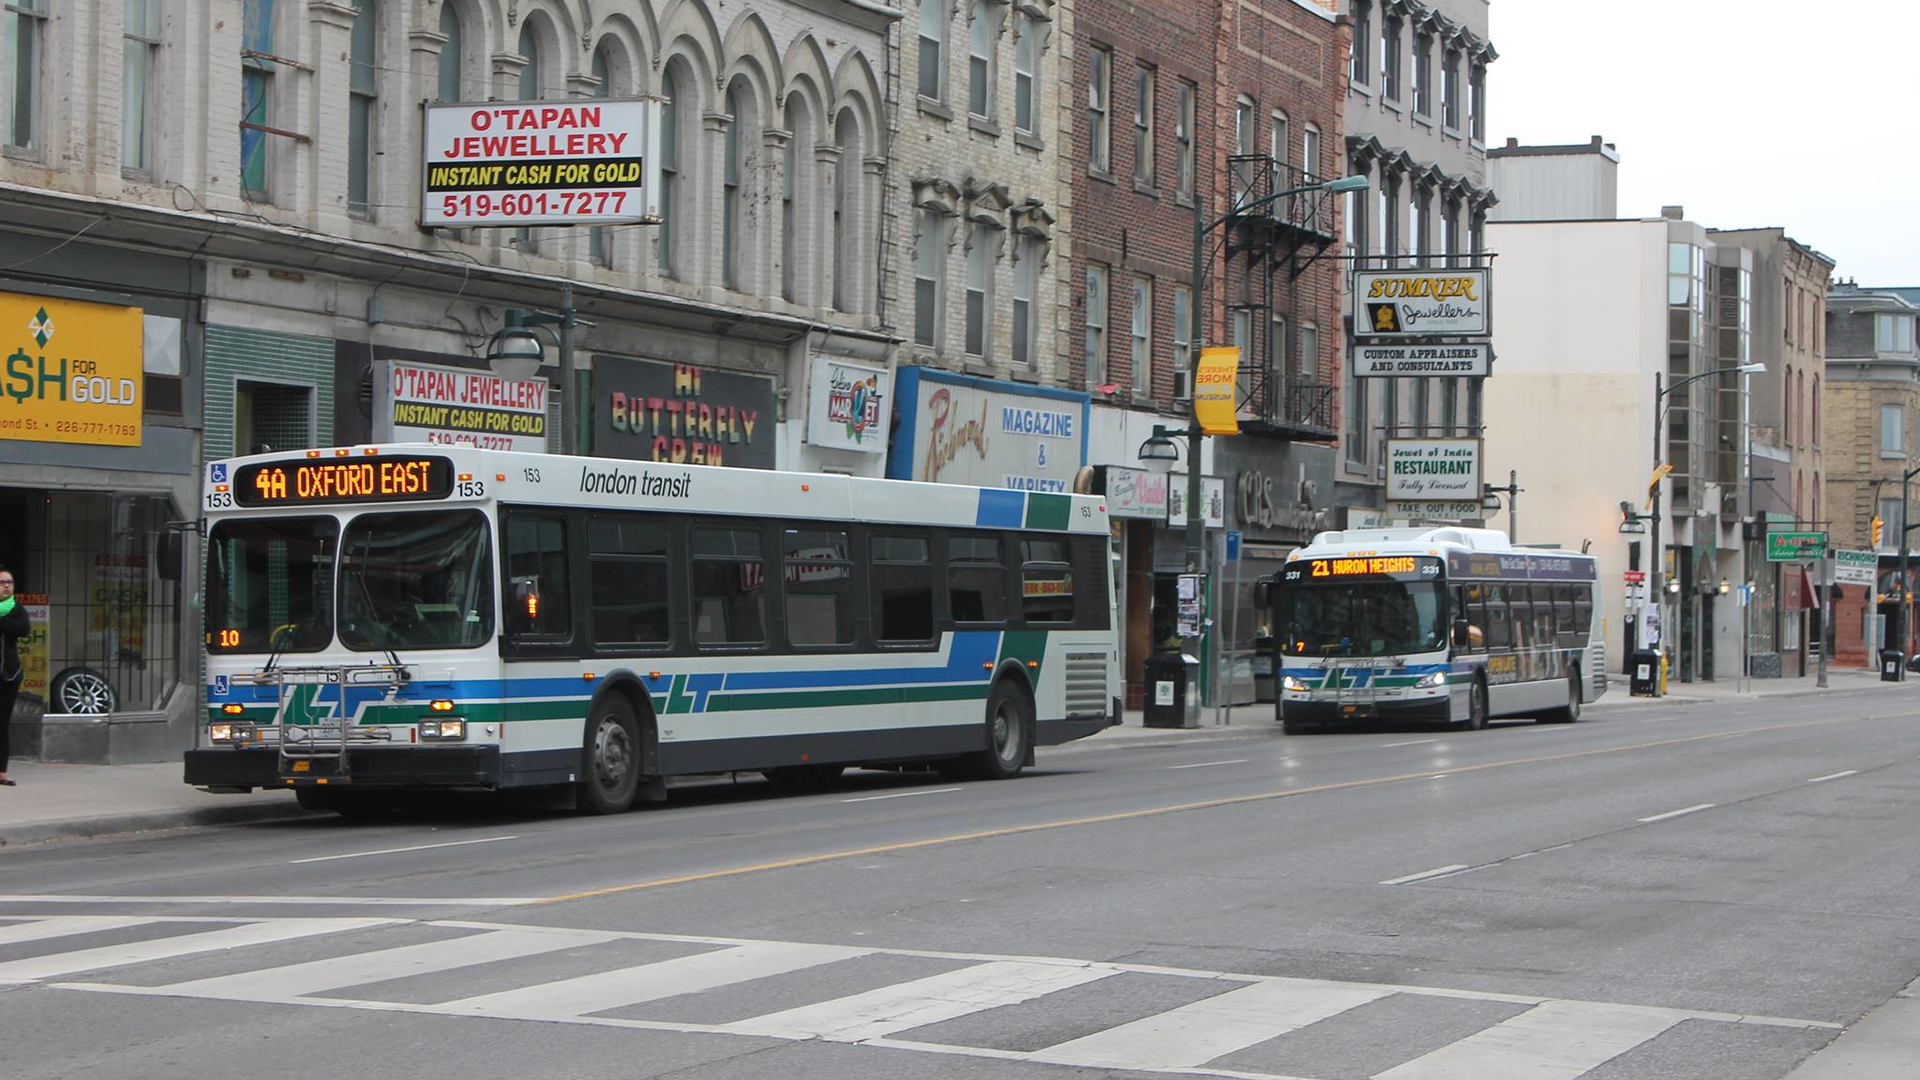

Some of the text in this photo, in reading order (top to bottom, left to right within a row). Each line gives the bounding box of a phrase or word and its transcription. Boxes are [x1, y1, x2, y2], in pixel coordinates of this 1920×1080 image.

[471, 107, 600, 131] O'TAPAN
[444, 133, 628, 158] JEWELLERY
[430, 162, 640, 186] INSTANT CASH FOR GOLD
[443, 191, 626, 217] 519-601-7277
[1368, 277, 1478, 301] SUMNER
[1402, 303, 1481, 325] Jewellers
[1364, 349, 1478, 360] CUSTOM APPRAISERS
[0, 347, 67, 404] $H
[72, 360, 97, 375] FOR
[1370, 361, 1473, 371] AND CONSULTANTS
[393, 367, 546, 410] O'TAPAN JEWELLERY
[674, 363, 701, 396] HI
[72, 374, 136, 406] GOLD
[394, 404, 544, 434] INSTANT CASH FOR GOLD
[610, 392, 757, 444] BUTTERFLY
[1002, 407, 1072, 437] MAGAZINE
[1037, 444, 1046, 466] &
[1392, 447, 1473, 457] Jewel of India
[523, 467, 541, 483] 153
[1394, 461, 1472, 475] RESTAURANT
[256, 461, 430, 499] 4A OXFORD EAST
[456, 481, 484, 497] 153
[580, 466, 691, 498] london transit
[1006, 476, 1065, 492] VARIETY
[206, 492, 232, 507] 153
[1397, 503, 1476, 513] TAKE OUT FOOD
[1081, 506, 1092, 518] 153
[1286, 570, 1300, 580] 331
[1312, 557, 1416, 577] 21 HURON HEIGHTS
[1422, 565, 1439, 575] 331
[220, 629, 240, 647] 10
[1296, 641, 1305, 652] 7
[326, 671, 348, 683] 15
